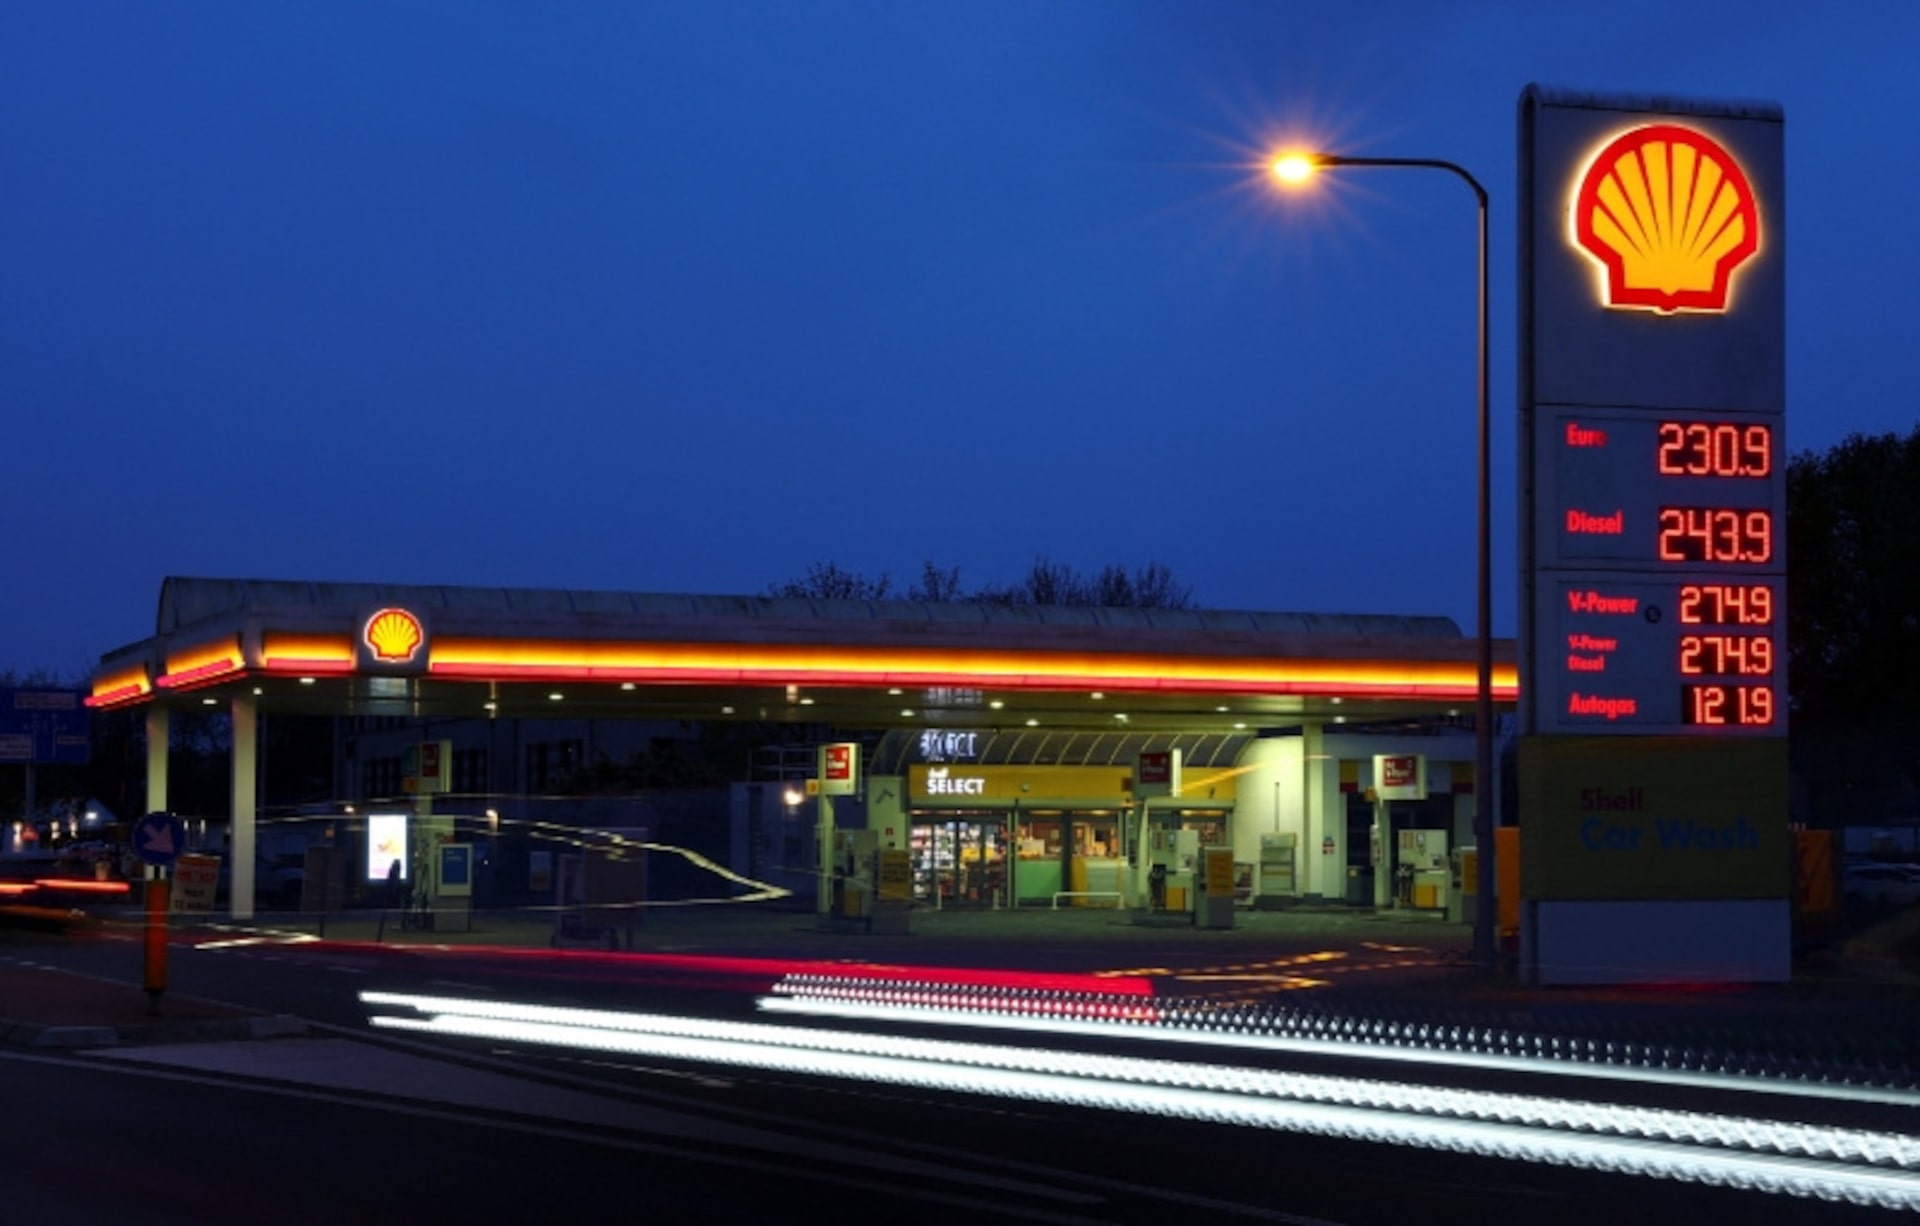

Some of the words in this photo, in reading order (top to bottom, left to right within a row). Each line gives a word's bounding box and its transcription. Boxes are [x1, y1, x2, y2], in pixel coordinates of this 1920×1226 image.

[1565, 422, 1607, 446] Euro
[1659, 422, 1771, 477] 230.9
[1566, 509, 1624, 535] Diesel
[1659, 508, 1771, 563] 243.9
[1568, 590, 1638, 614] V-Power
[1680, 586, 1772, 623] 274.9
[1568, 634, 1618, 651] V-Power
[1680, 636, 1772, 674] 274.9
[1568, 655, 1605, 671] Diesel
[1568, 692, 1637, 721] Autogas
[926, 779, 985, 795] SELECT
[1580, 786, 1643, 812] Shell
[1580, 816, 1647, 851] Car
[1655, 814, 1760, 851] Wash
